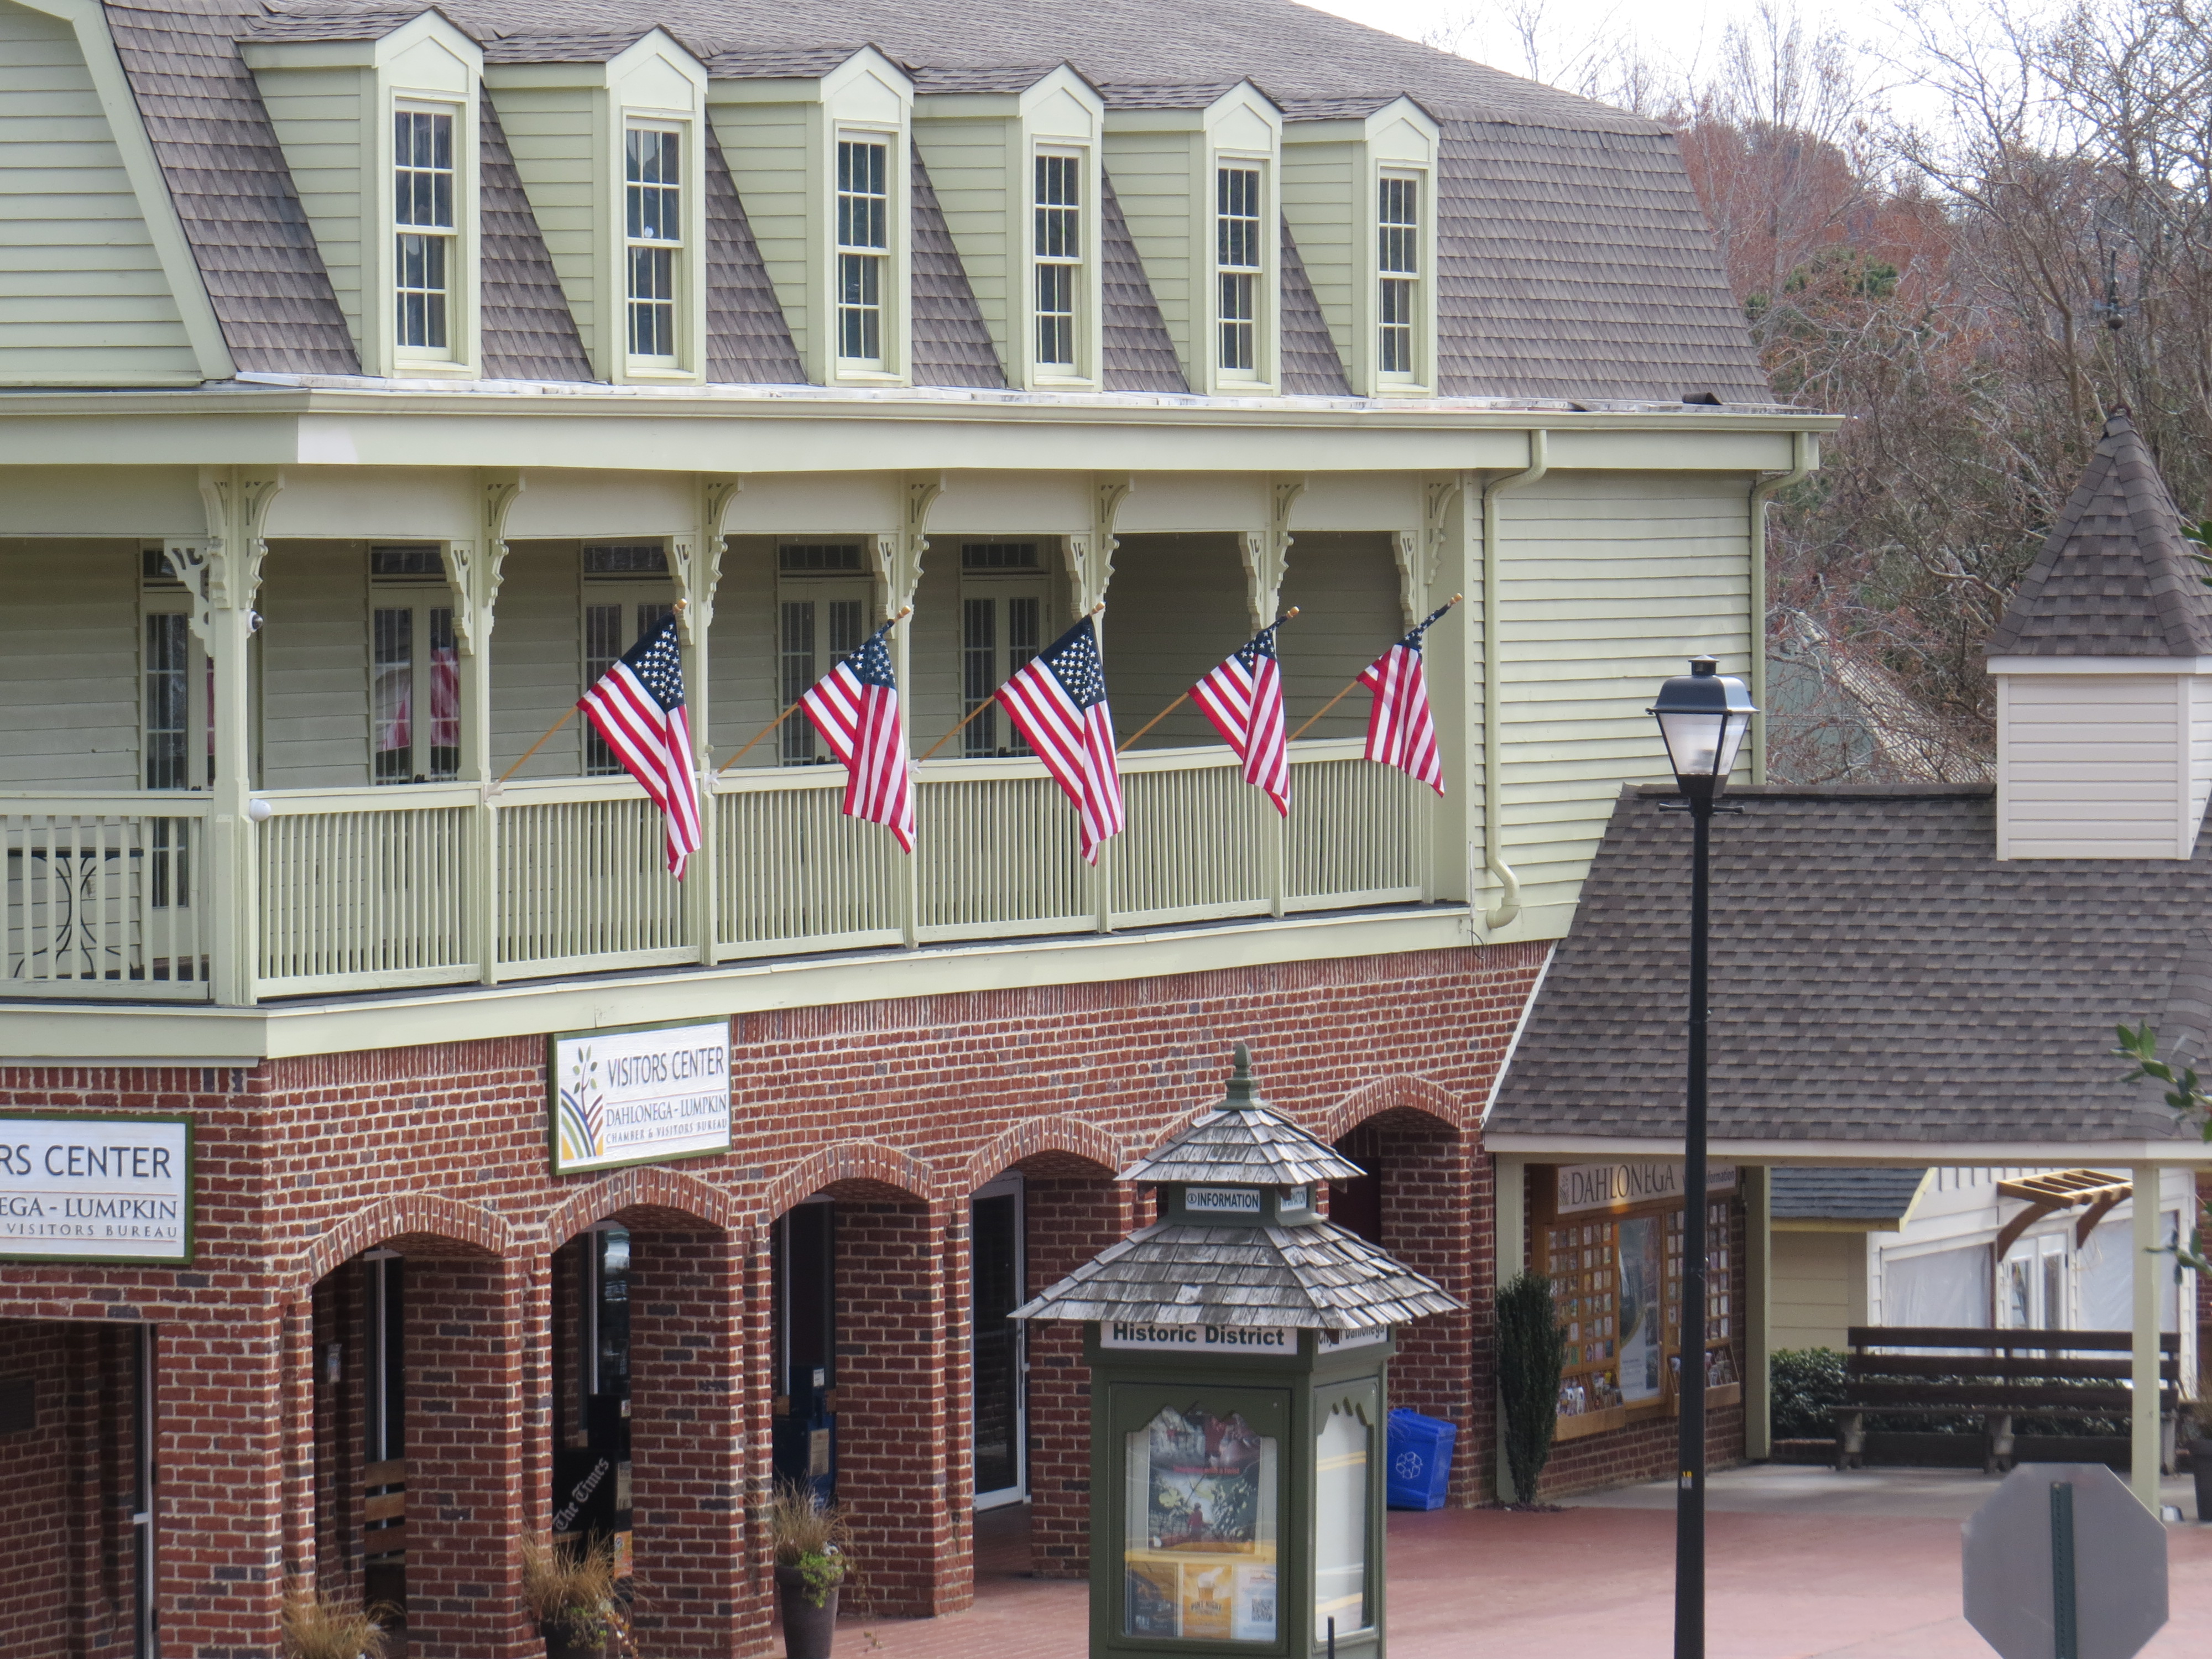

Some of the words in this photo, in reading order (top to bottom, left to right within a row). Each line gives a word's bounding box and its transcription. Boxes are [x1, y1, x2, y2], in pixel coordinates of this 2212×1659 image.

[607, 1053, 667, 1088] VISITORS
[671, 1046, 724, 1079] CENTER
[606, 1101, 673, 1127] DAHLONEGA
[681, 1094, 727, 1117] LUMPKIN
[606, 1129, 644, 1144] CHAMBER
[656, 1123, 693, 1137] VISITORS
[697, 1118, 727, 1131] BUREAU
[45, 1145, 171, 1178] CENTER
[1572, 1165, 1676, 1205] DAHLONEGA
[65, 1198, 178, 1219] LUMPKIN
[1198, 1192, 1259, 1208] INFORMATION
[7, 1223, 94, 1235] VISITORS
[106, 1225, 178, 1238] BUREAU
[1113, 1322, 1197, 1343] Historic
[1204, 1324, 1285, 1346] District
[553, 1501, 579, 1531] The
[572, 1457, 609, 1503] Times
